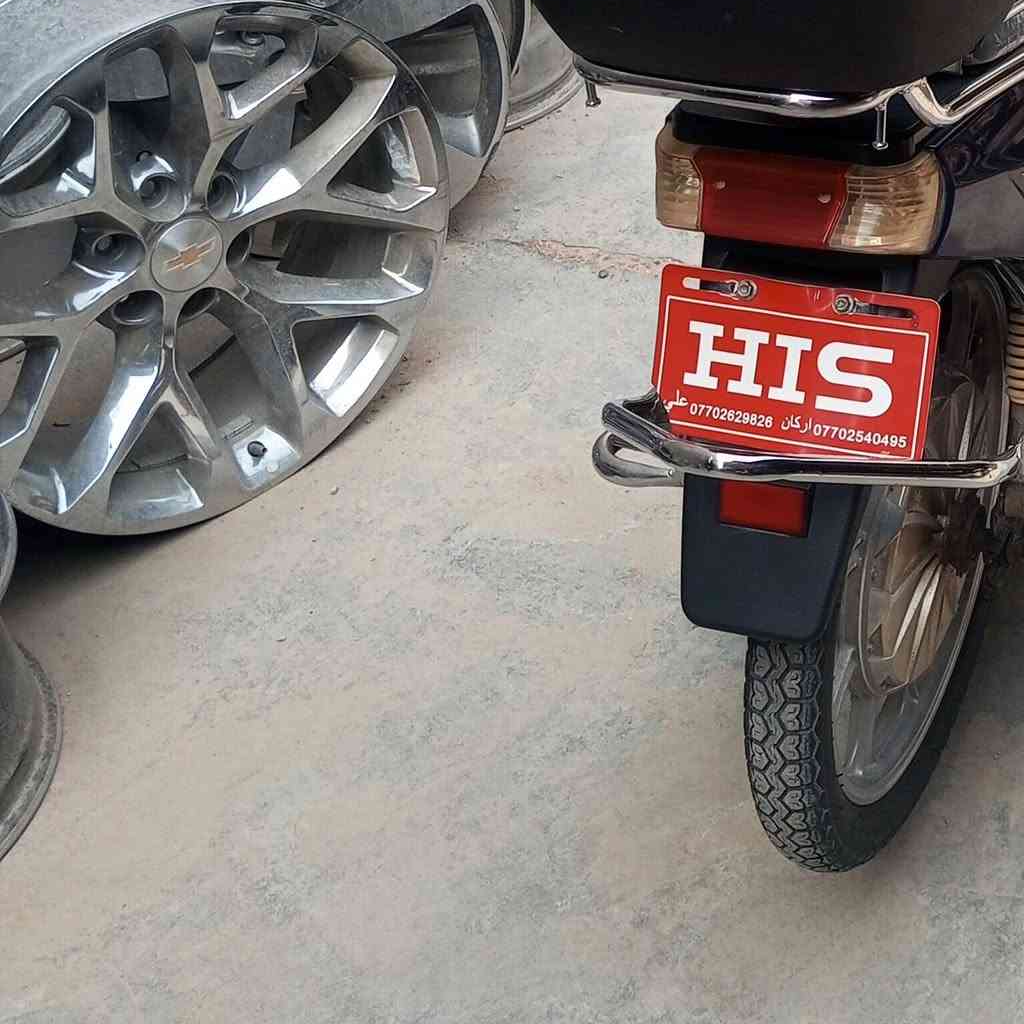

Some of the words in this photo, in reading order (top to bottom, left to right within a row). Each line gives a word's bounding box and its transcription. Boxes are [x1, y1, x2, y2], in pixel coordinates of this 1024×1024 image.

[683, 321, 895, 418] HIS
[689, 403, 773, 428] 07702629826
[813, 424, 908, 449] 07702540495
